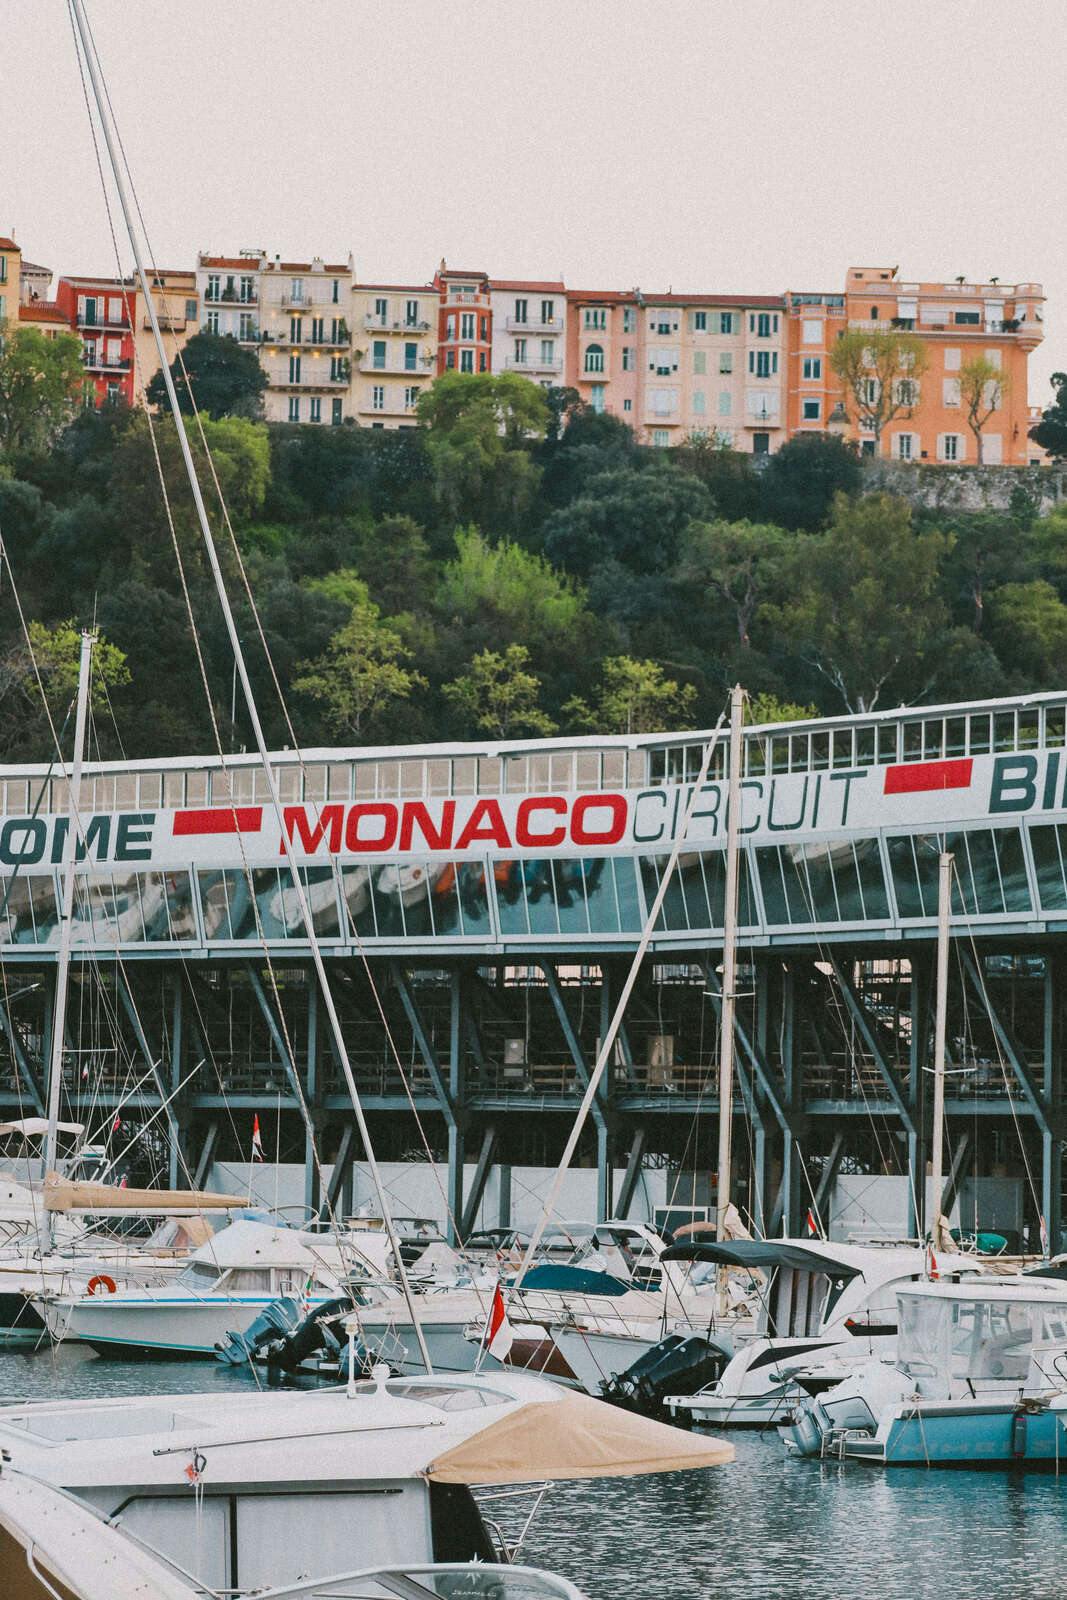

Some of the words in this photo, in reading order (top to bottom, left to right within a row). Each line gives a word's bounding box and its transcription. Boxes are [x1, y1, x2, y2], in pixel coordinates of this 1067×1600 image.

[0, 813, 156, 865] OME
[279, 794, 628, 855] MONACO
[632, 770, 868, 843] CIRCUIT
[988, 752, 1067, 814] BI
